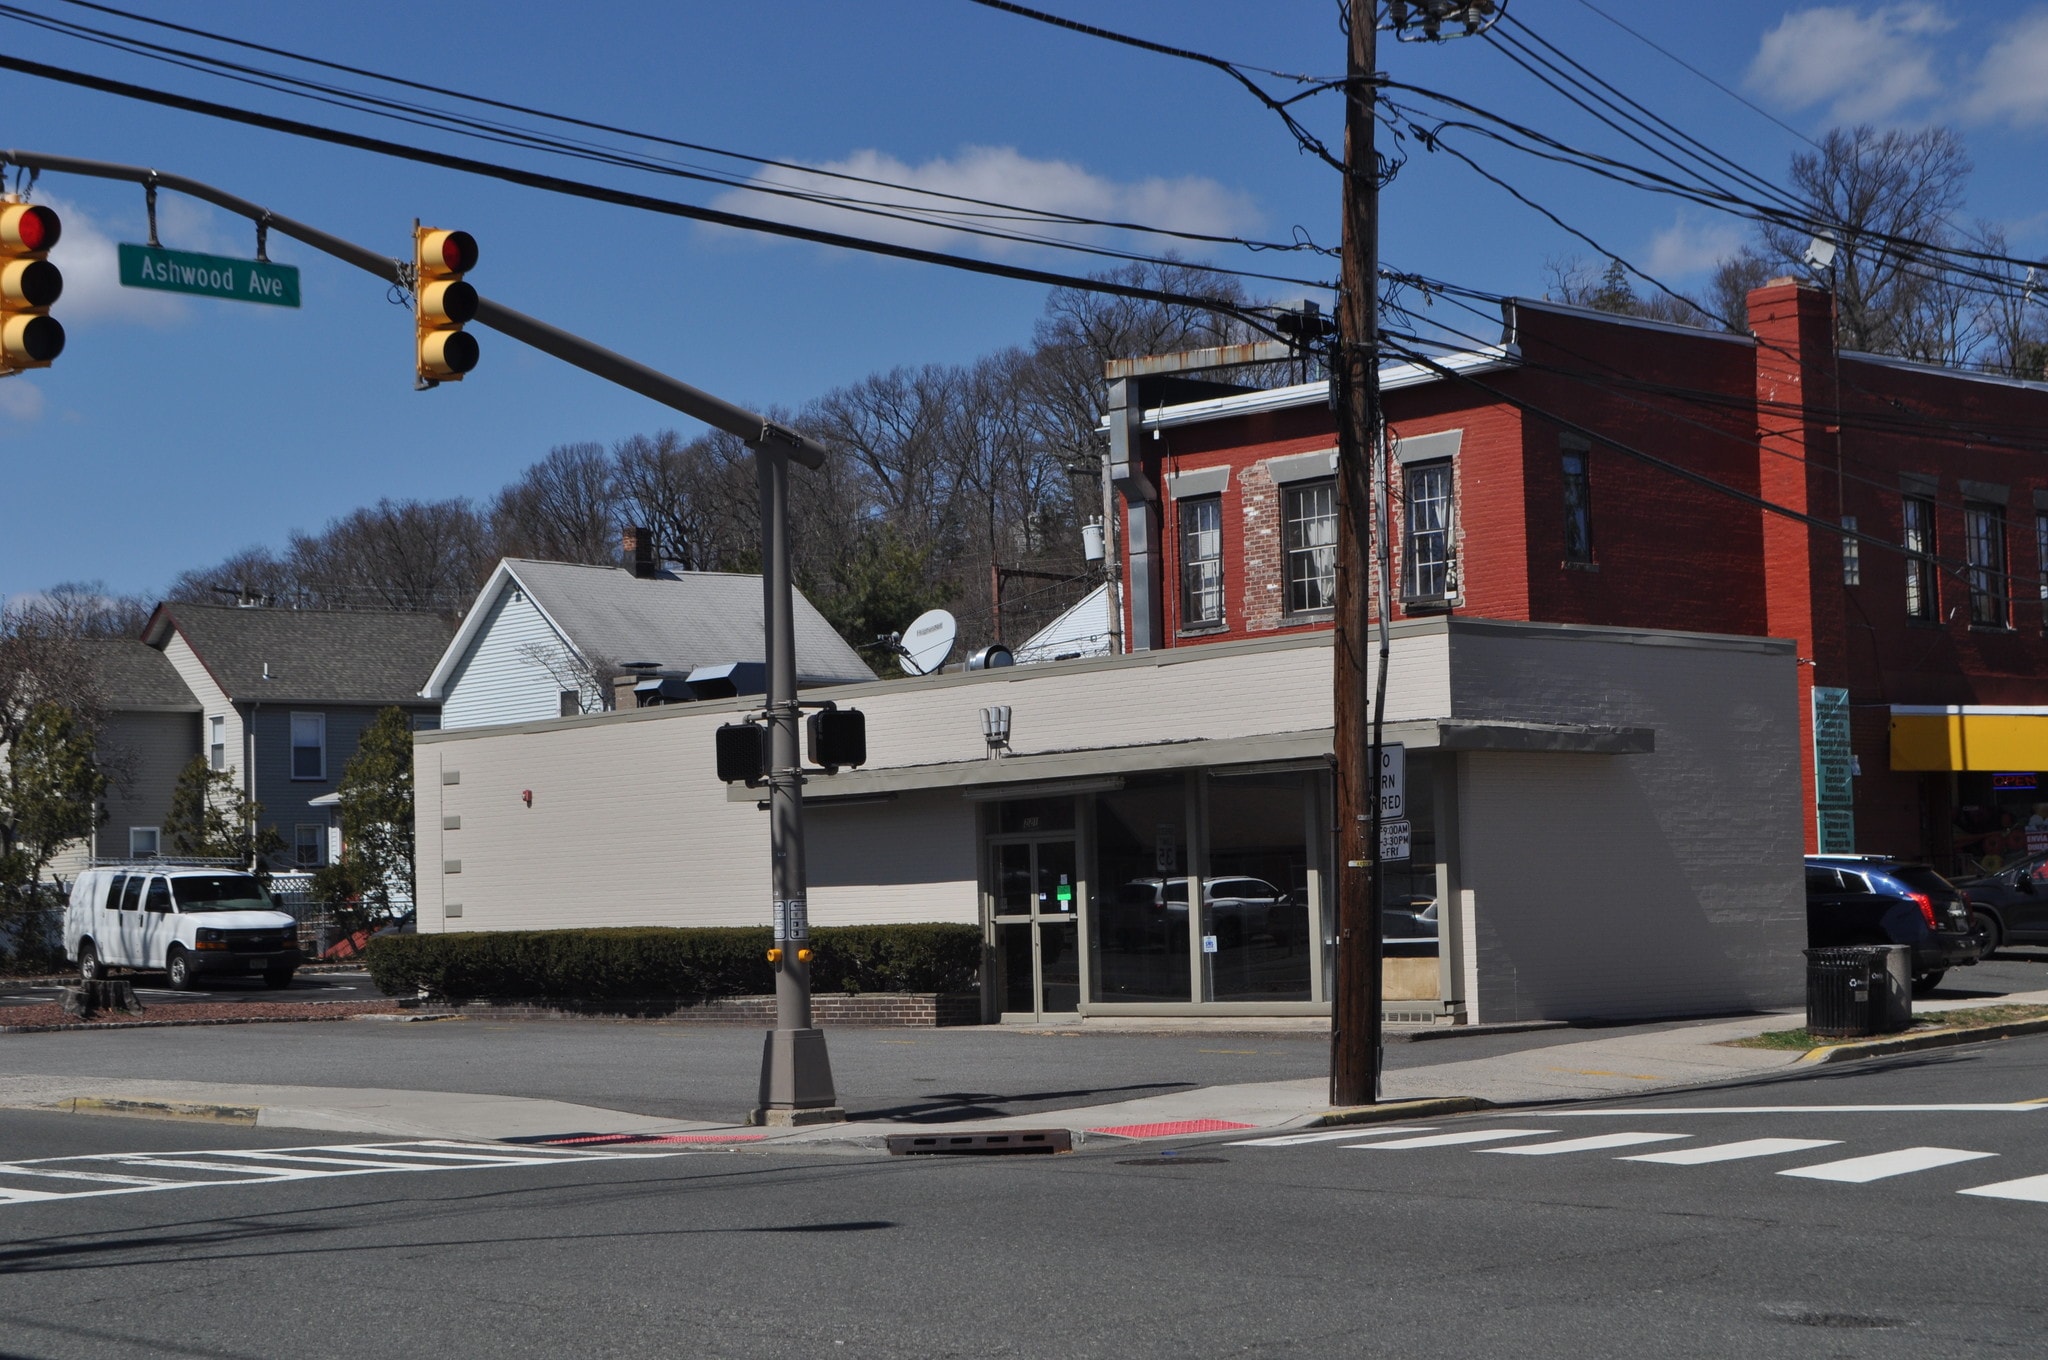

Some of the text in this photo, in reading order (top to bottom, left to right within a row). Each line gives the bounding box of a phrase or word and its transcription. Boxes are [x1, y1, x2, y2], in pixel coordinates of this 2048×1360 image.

[142, 256, 283, 297] Ashwood Ave
[1382, 754, 1390, 767] O
[1381, 774, 1395, 789] RN
[1993, 775, 2037, 787] OPEN
[1381, 795, 1400, 810] RED
